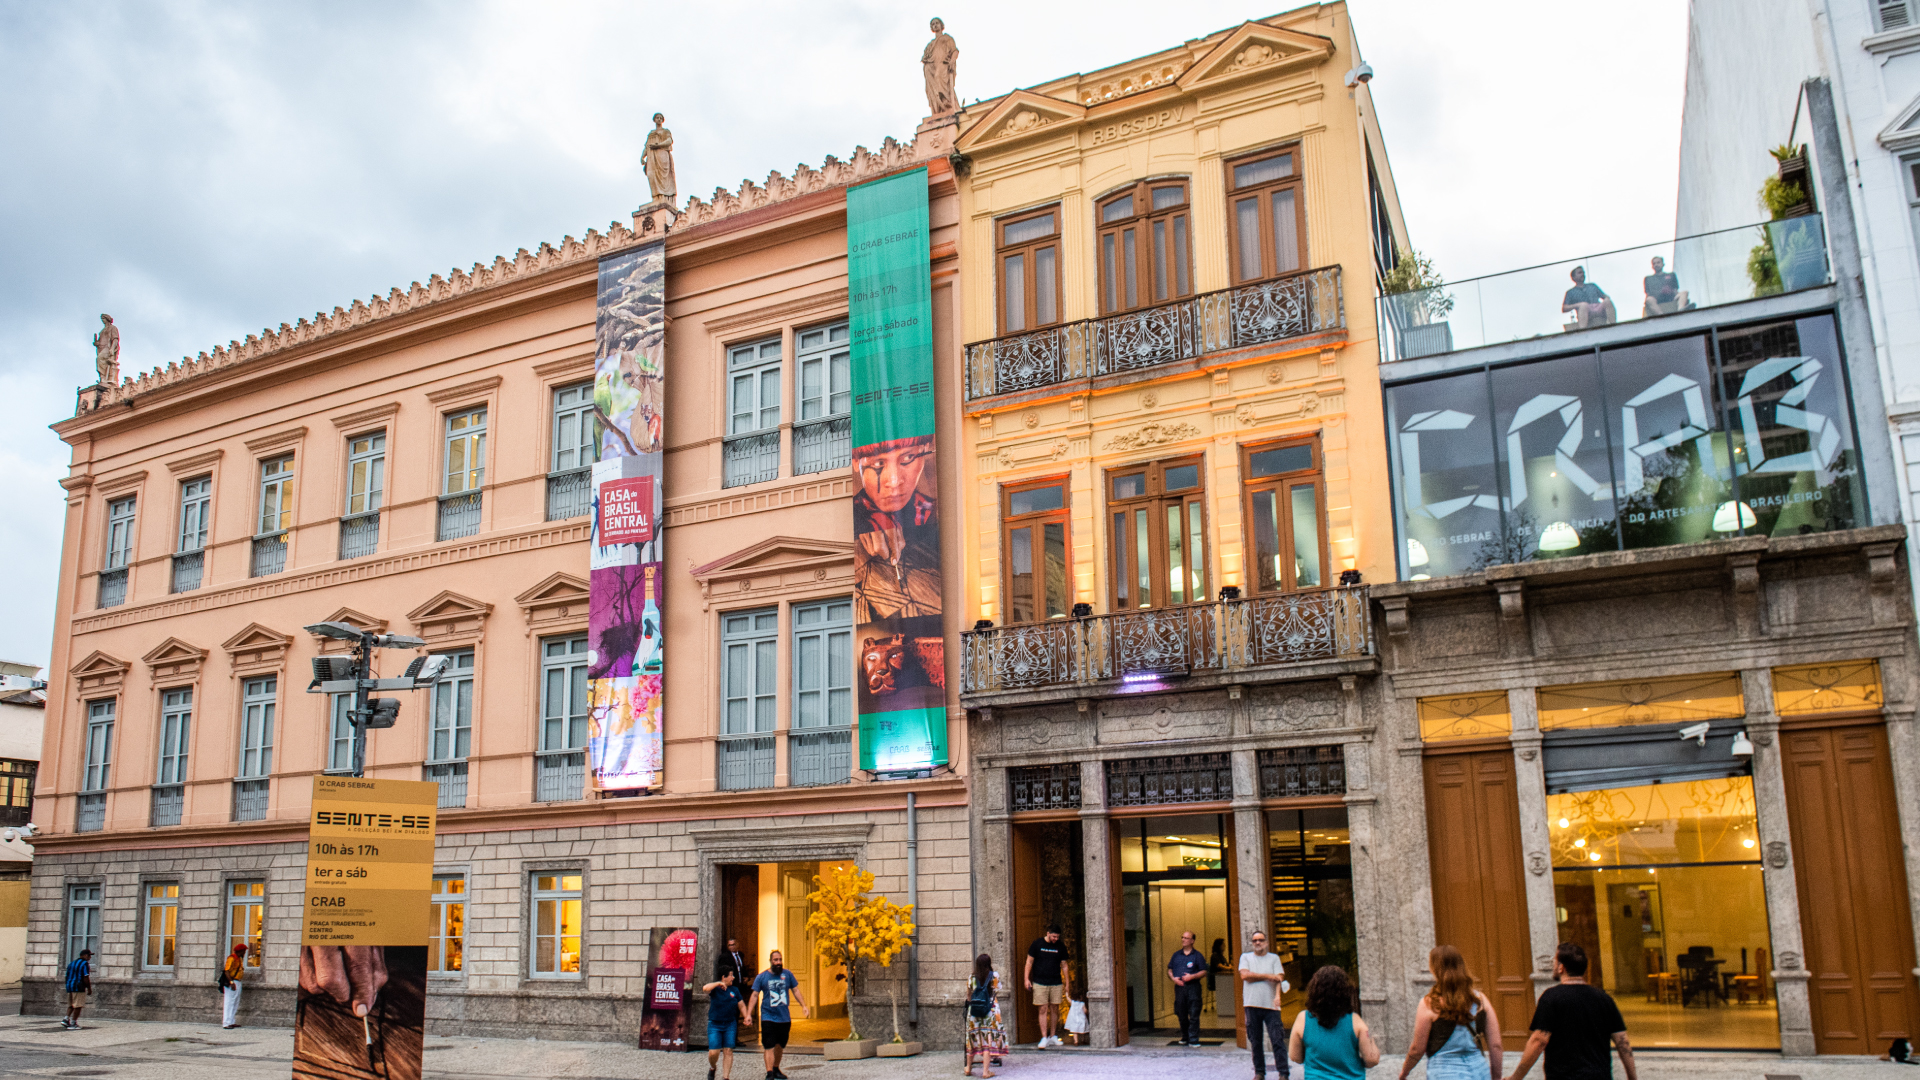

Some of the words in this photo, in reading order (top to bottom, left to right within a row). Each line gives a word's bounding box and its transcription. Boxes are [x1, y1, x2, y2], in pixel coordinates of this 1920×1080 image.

[1092, 105, 1185, 145] RBCSDPV
[852, 245, 859, 253] O
[860, 239, 883, 251] CRAB
[884, 229, 919, 245] SEBRAE
[853, 292, 868, 304] 10h
[869, 289, 880, 299] às
[882, 285, 898, 296] 17h
[854, 327, 875, 339] terça
[876, 324, 883, 332] a
[884, 317, 919, 331] sábado
[855, 381, 930, 406] SENTE-SE
[1399, 356, 1842, 520] CRAB
[604, 488, 631, 504] CASA
[604, 501, 641, 518] BRASIL
[1449, 531, 1493, 544] SEBRAE
[1517, 526, 1533, 536] DE
[1629, 511, 1646, 522] DO
[1750, 491, 1823, 509] BRASILEIRO
[604, 514, 648, 531] CENTRAL
[326, 780, 346, 788] CRAB
[316, 811, 431, 829] SENTE-SE
[315, 843, 337, 855] 10h
[340, 844, 355, 856] às
[358, 845, 379, 856] 17h
[315, 867, 334, 878] ter
[335, 869, 343, 878] a
[346, 866, 368, 878] sáb
[311, 896, 346, 907] CRAB
[655, 982, 676, 991] BRASIL
[656, 974, 672, 983] CASA
[655, 990, 680, 1000] CENTRAL
